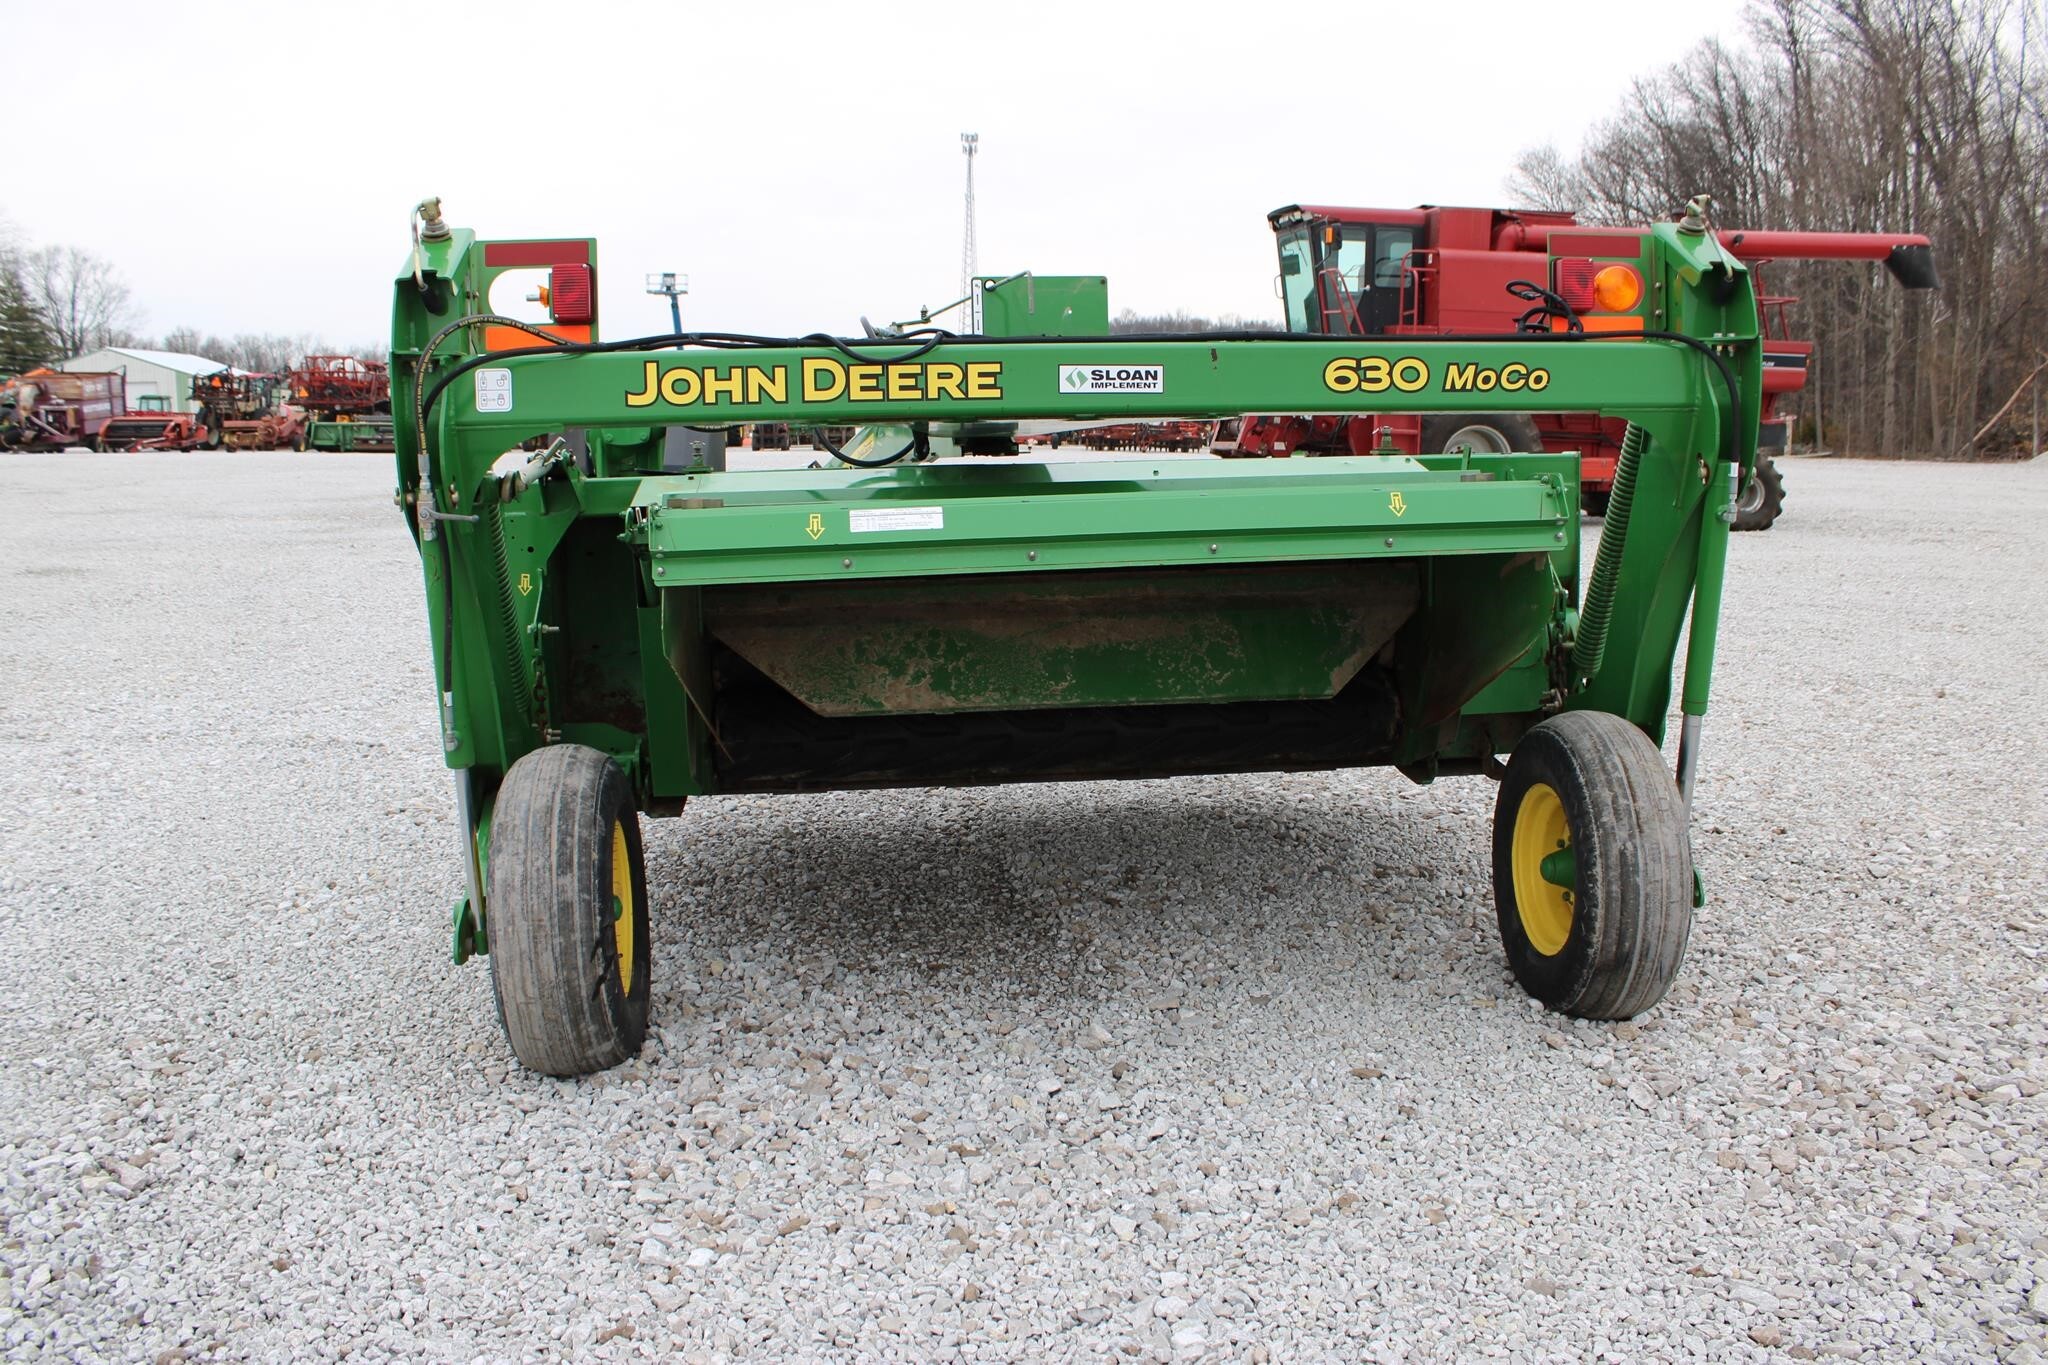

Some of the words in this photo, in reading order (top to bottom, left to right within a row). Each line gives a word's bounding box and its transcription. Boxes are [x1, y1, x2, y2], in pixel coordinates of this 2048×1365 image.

[626, 360, 788, 407] JOHN
[801, 357, 1003, 403] DEERE
[1091, 369, 1158, 381] SLOAN
[1323, 356, 1430, 394] 630
[1442, 362, 1550, 392] MoCo
